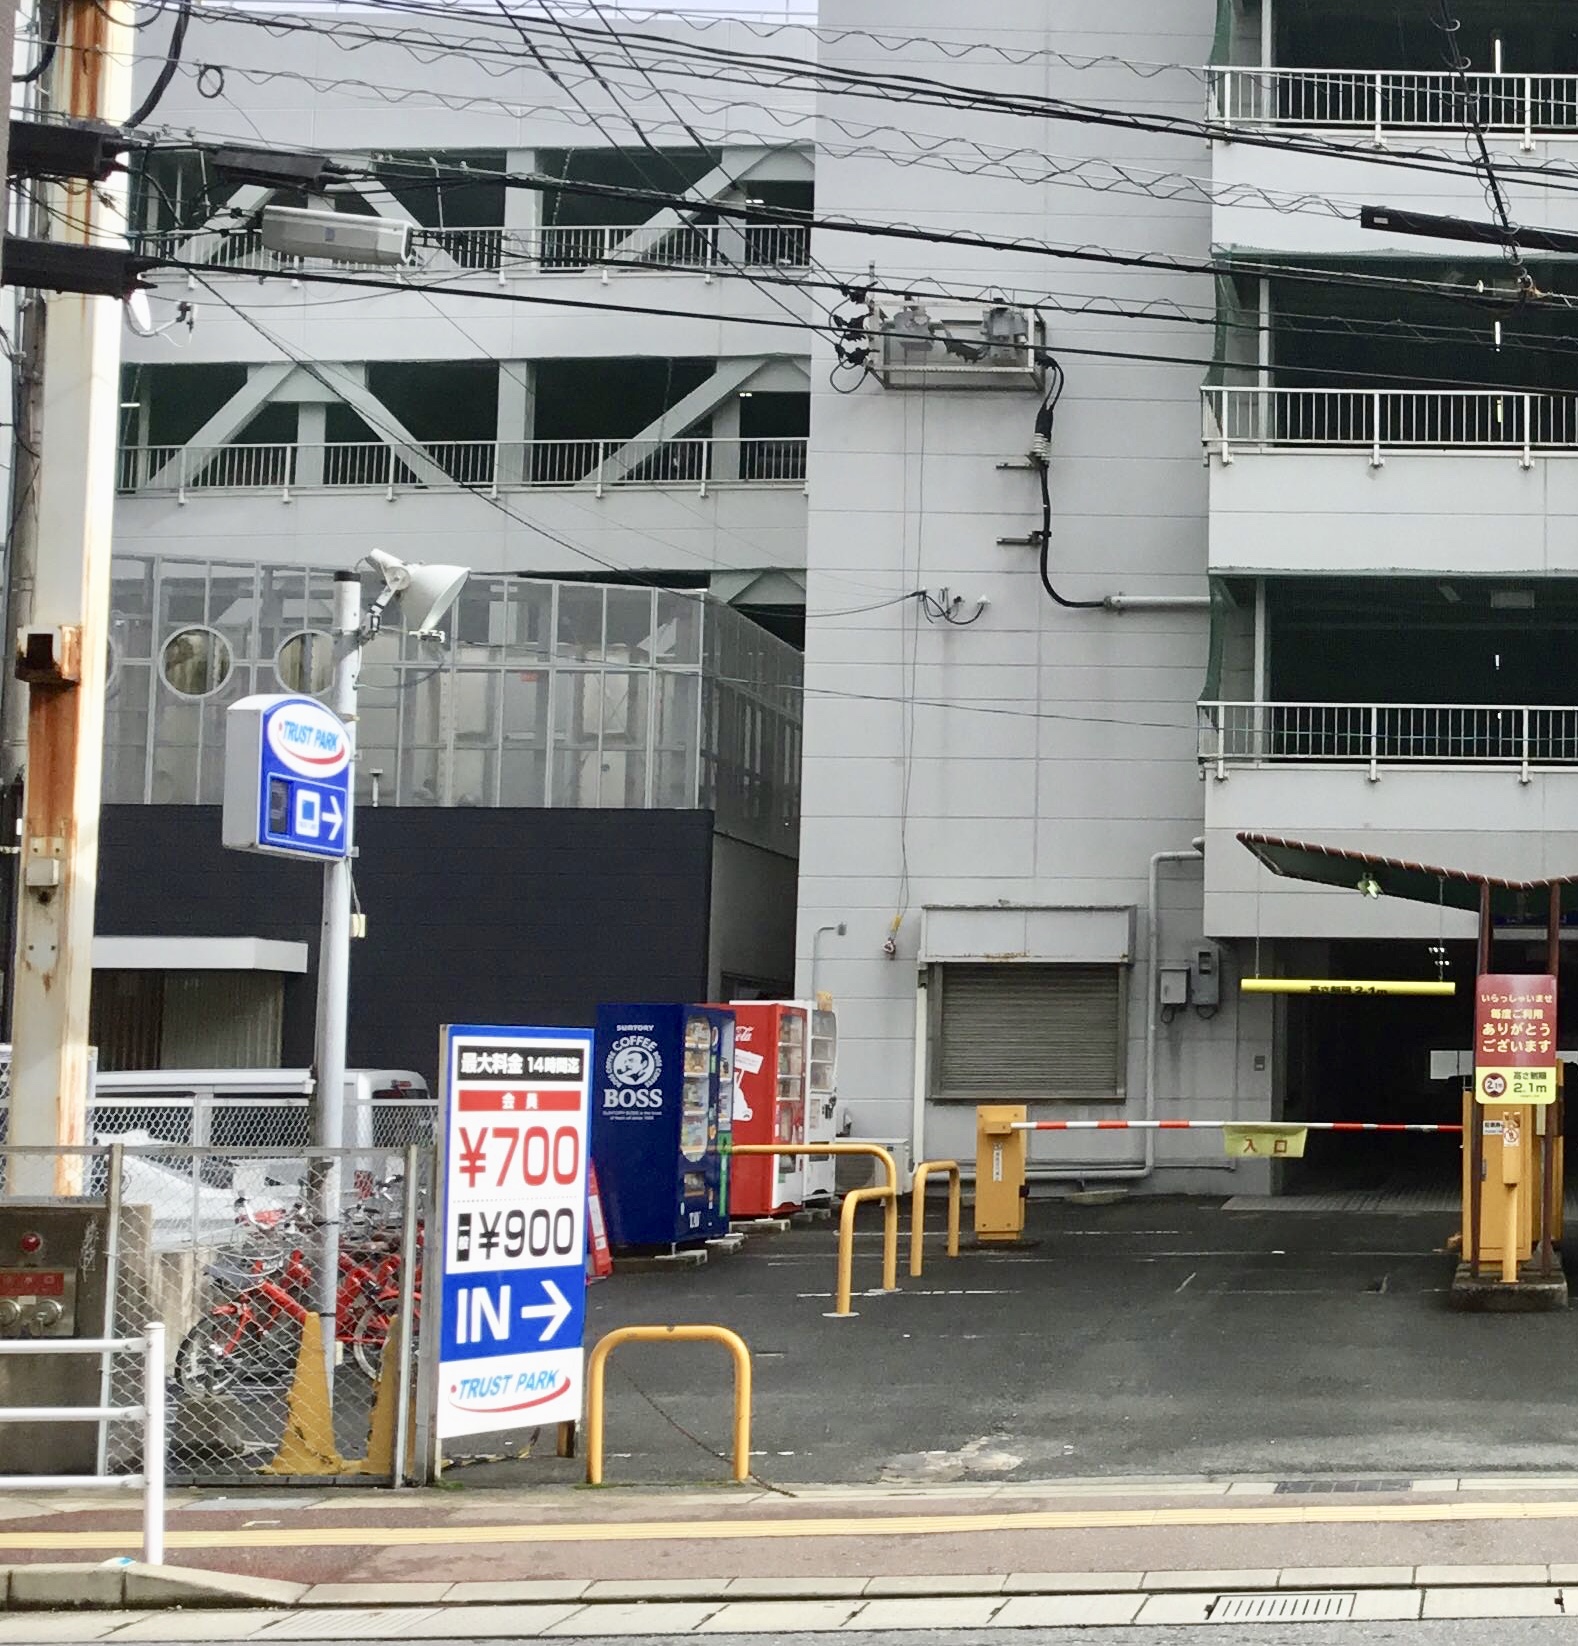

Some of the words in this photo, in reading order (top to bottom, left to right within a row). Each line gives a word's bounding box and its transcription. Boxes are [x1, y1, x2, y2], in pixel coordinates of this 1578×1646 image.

[283, 720, 313, 747] TRUST
[315, 731, 339, 752] PARK
[1482, 1023, 1551, 1036] ありがとう
[612, 1035, 658, 1052] COFFEE
[1482, 1039, 1552, 1053] ございます
[461, 1052, 524, 1074] 最大料金
[603, 1088, 663, 1107] BOSS
[1514, 1082, 1547, 1093] 2.1m
[1244, 1137, 1287, 1154] 入口
[458, 1126, 580, 1187] ¥700
[478, 1208, 575, 1259] ¥900
[456, 1285, 511, 1344] IN
[459, 1374, 513, 1400] TRUST
[514, 1369, 559, 1393] PARK
